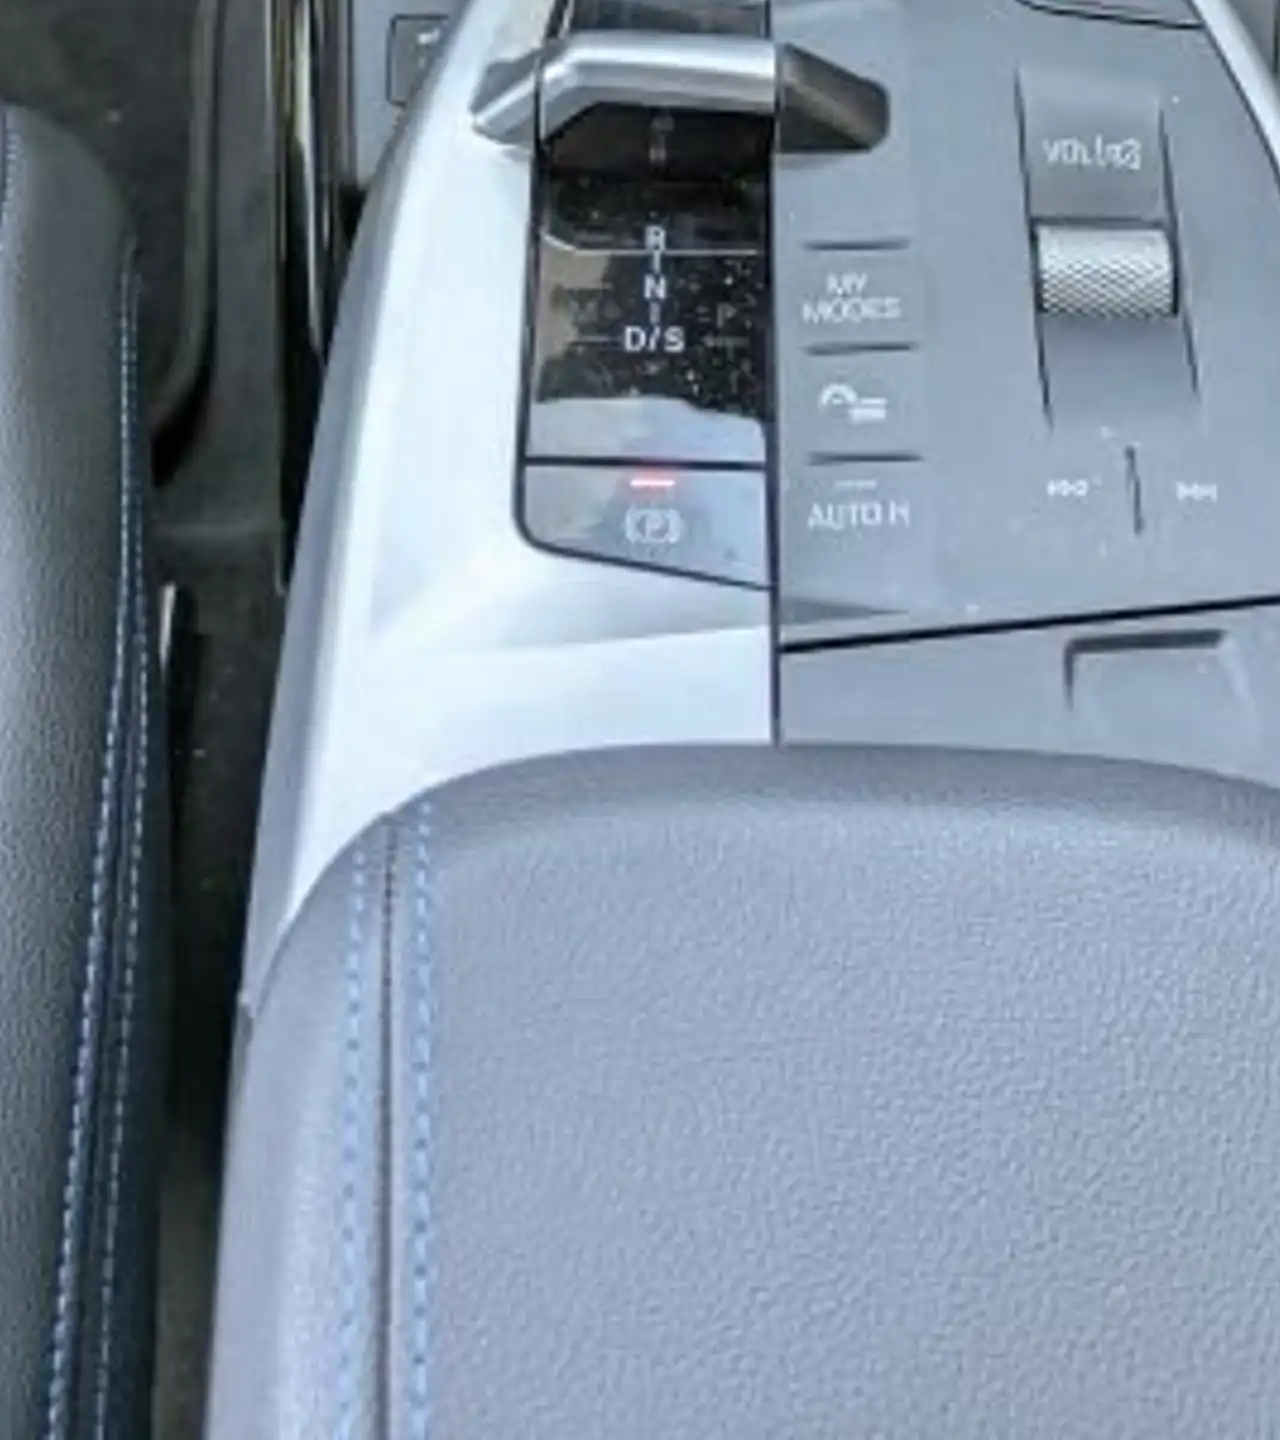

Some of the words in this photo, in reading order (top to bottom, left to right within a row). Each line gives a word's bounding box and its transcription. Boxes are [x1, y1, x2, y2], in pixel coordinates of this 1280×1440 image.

[644, 225, 667, 252] R
[643, 274, 667, 300] N
[826, 270, 869, 296] MY
[801, 295, 902, 325] MODES
[623, 324, 686, 352] D/S
[806, 501, 883, 530] AUTO
[888, 499, 911, 529] H
